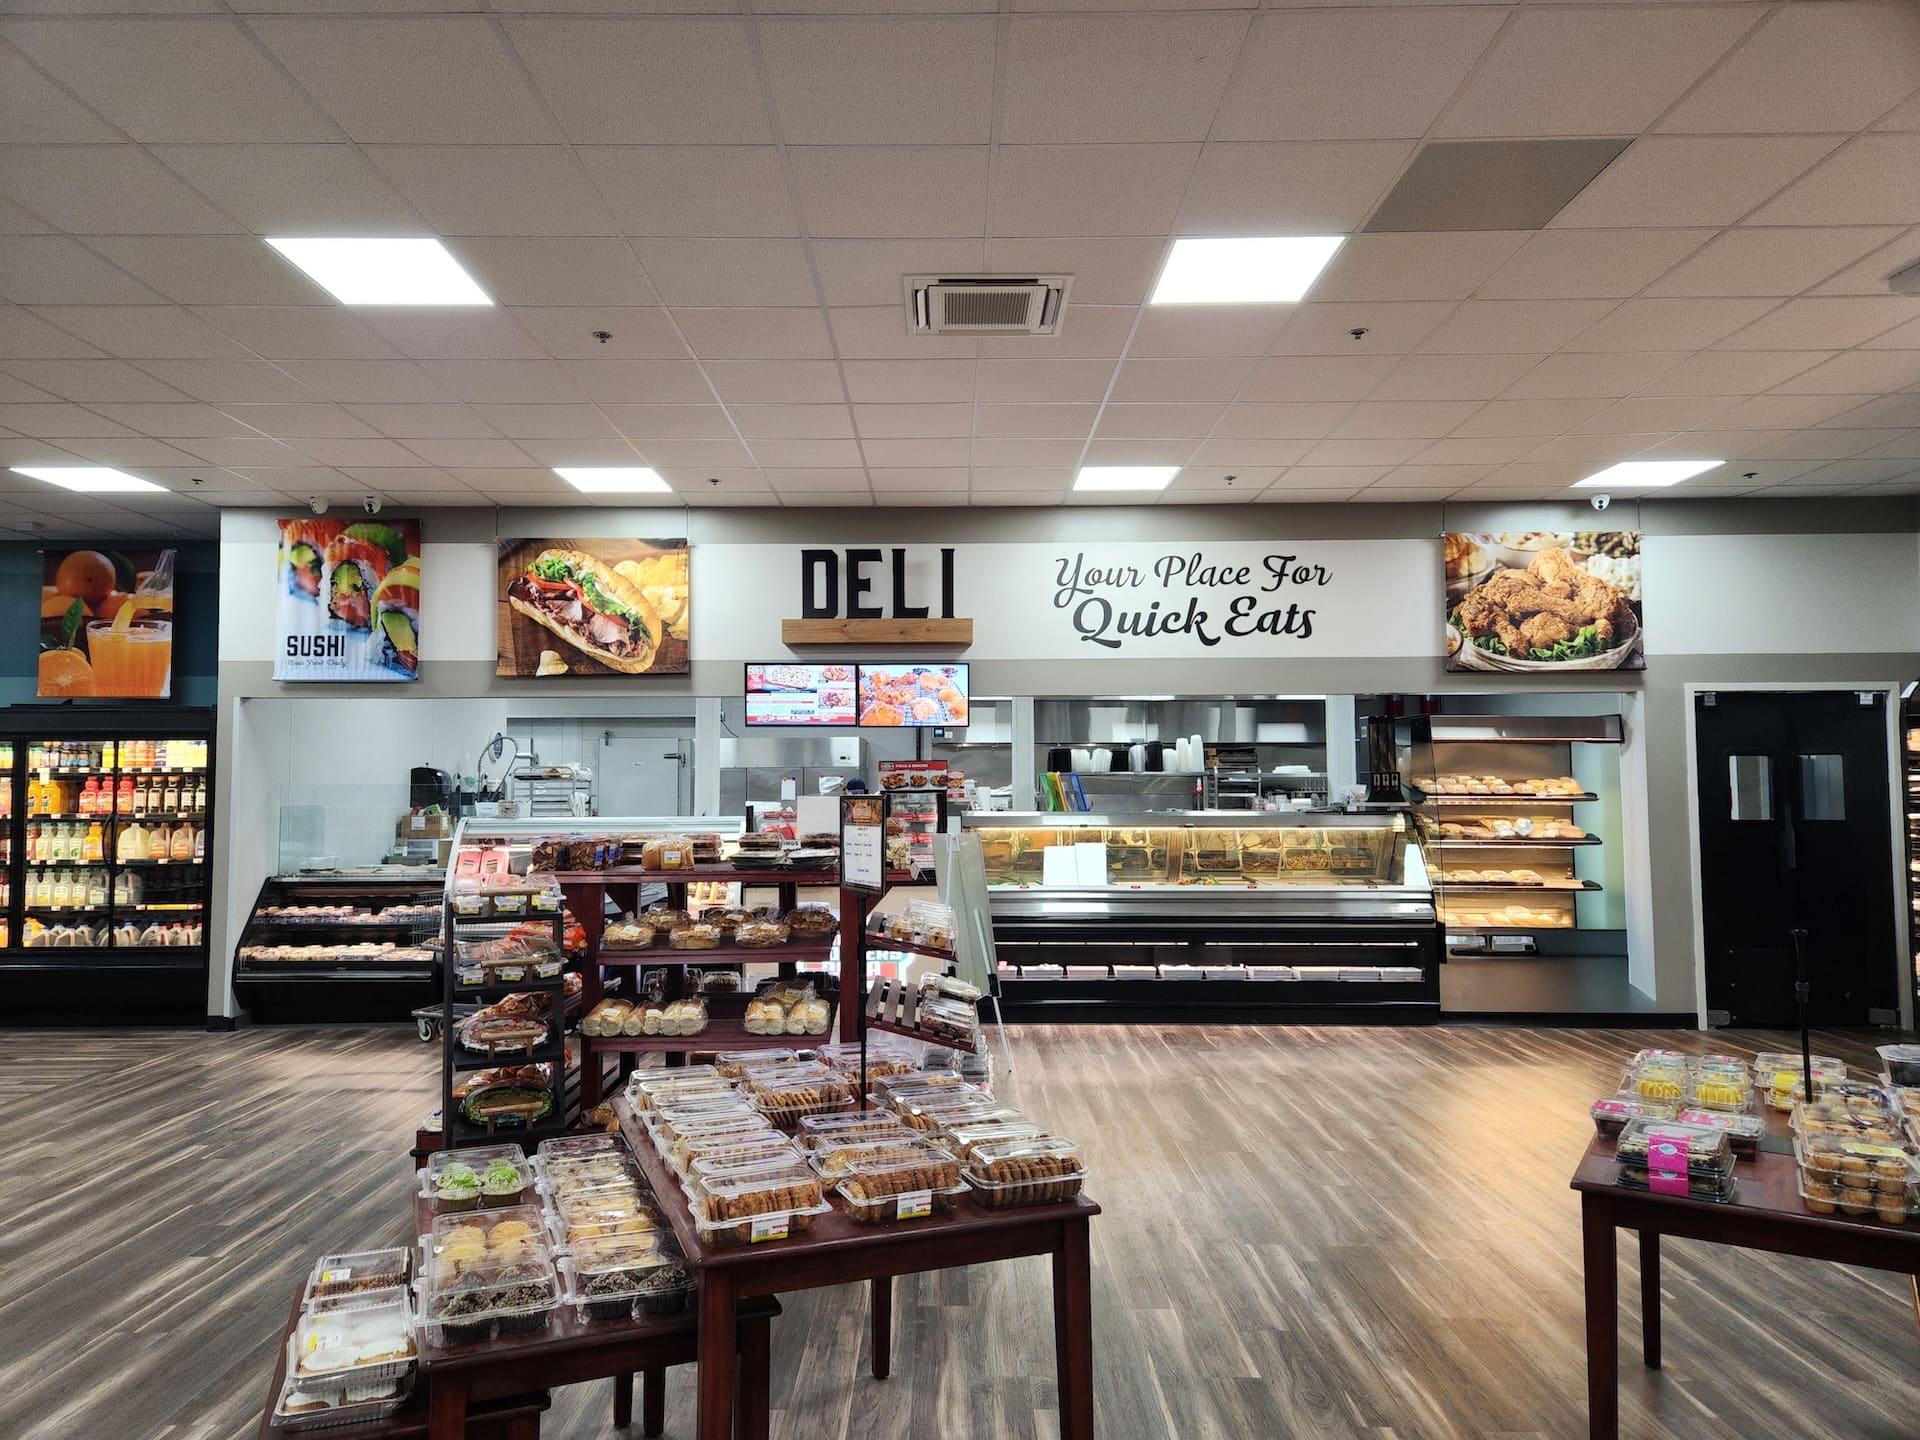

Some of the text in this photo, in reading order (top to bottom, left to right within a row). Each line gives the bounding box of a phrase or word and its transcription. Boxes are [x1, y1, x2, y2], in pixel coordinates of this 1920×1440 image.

[801, 548, 955, 619] DELI
[1053, 552, 1334, 608] Your Place For
[287, 635, 345, 657] SUSHI
[1072, 595, 1316, 649] Quick Eats
